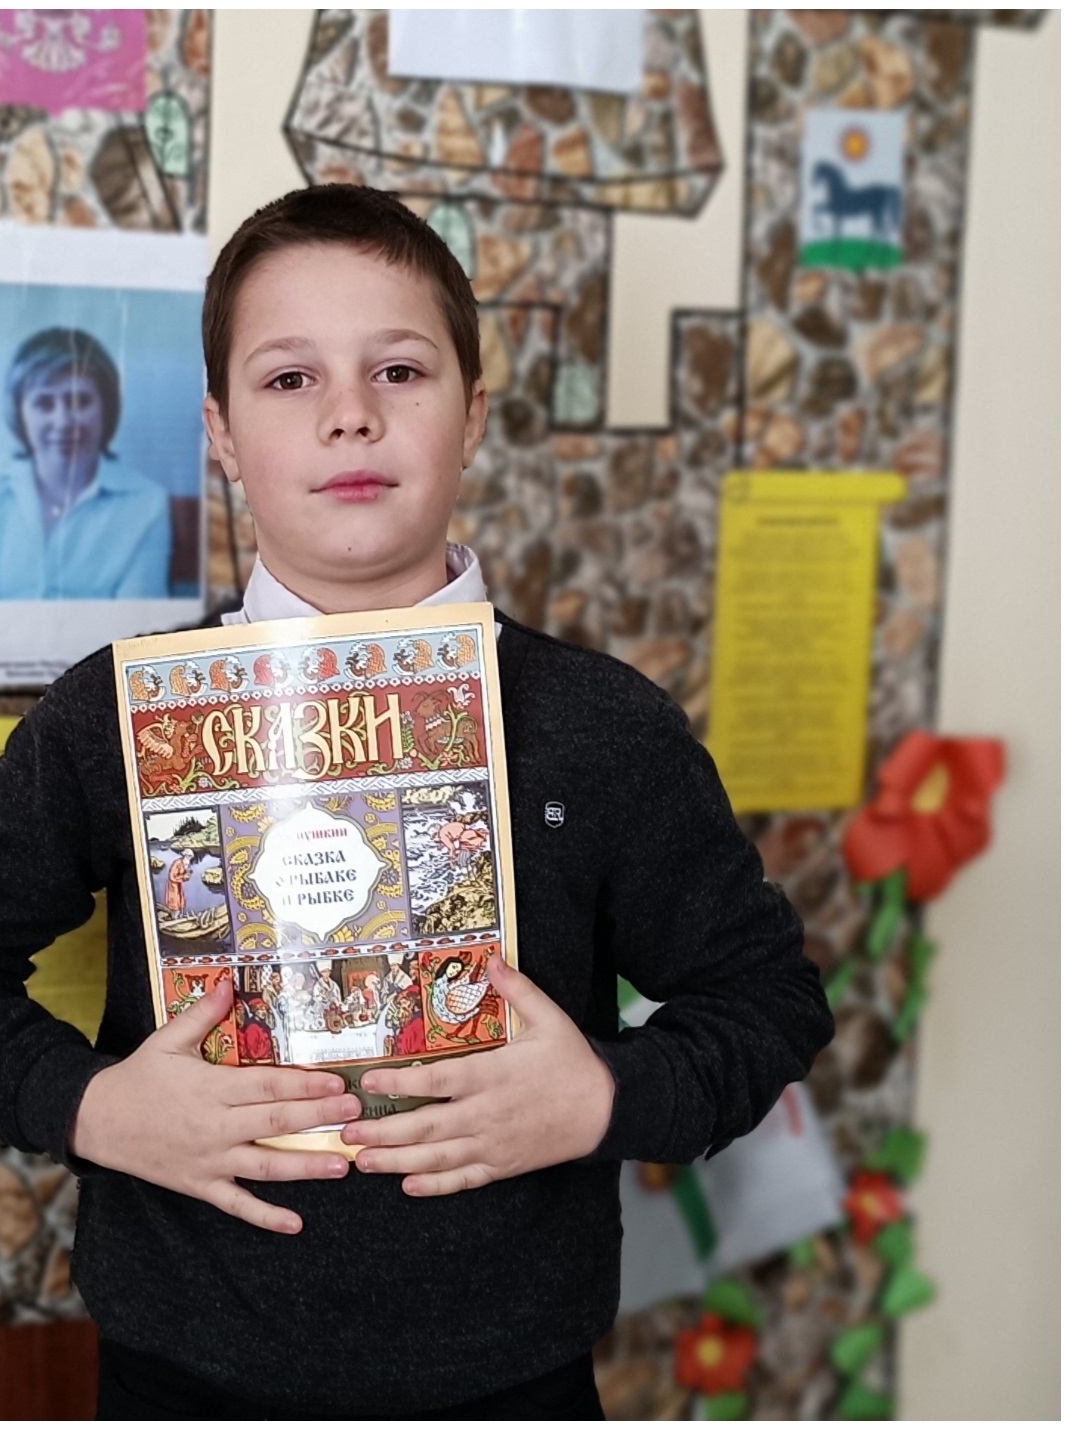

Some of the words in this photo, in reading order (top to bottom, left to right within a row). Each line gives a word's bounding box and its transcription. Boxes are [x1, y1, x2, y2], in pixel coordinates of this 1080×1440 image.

[201, 692, 405, 780] СКАЗКИ
[282, 850, 346, 866] СКАЗКА
[290, 869, 357, 886] РЫБАКЕ
[298, 889, 355, 905] РЫБКЕ
